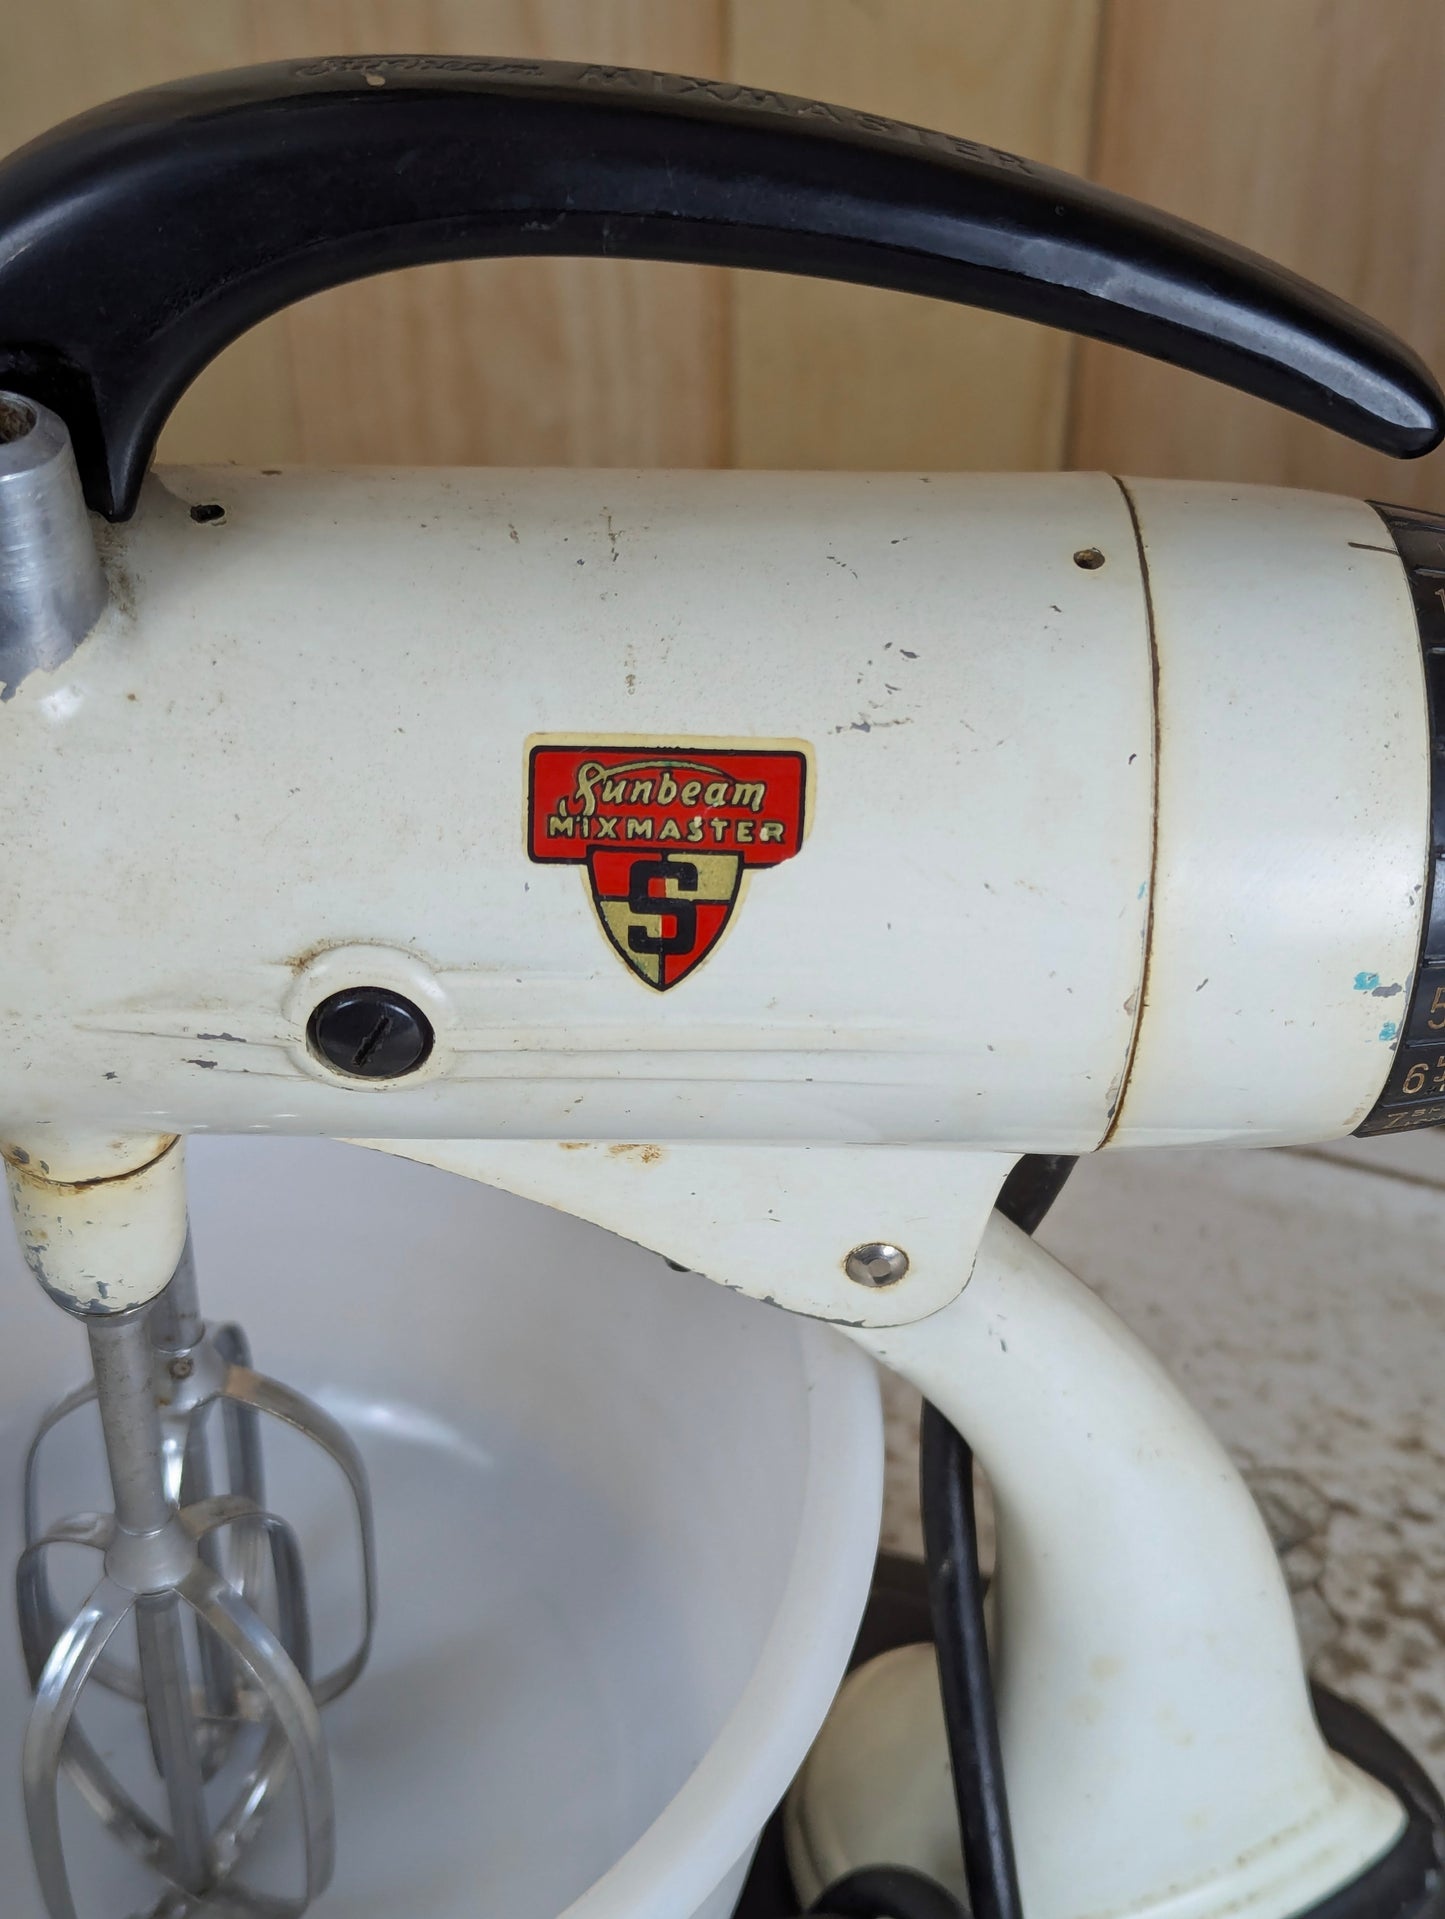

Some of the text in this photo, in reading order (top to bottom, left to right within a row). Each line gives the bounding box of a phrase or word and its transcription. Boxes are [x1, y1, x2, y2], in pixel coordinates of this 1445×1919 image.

[577, 64, 1035, 176] MIXMASTER
[557, 758, 767, 817] Sunbeam
[548, 814, 786, 844] MIXMASTER
[627, 860, 698, 955] S
[1402, 1063, 1429, 1094] 6
